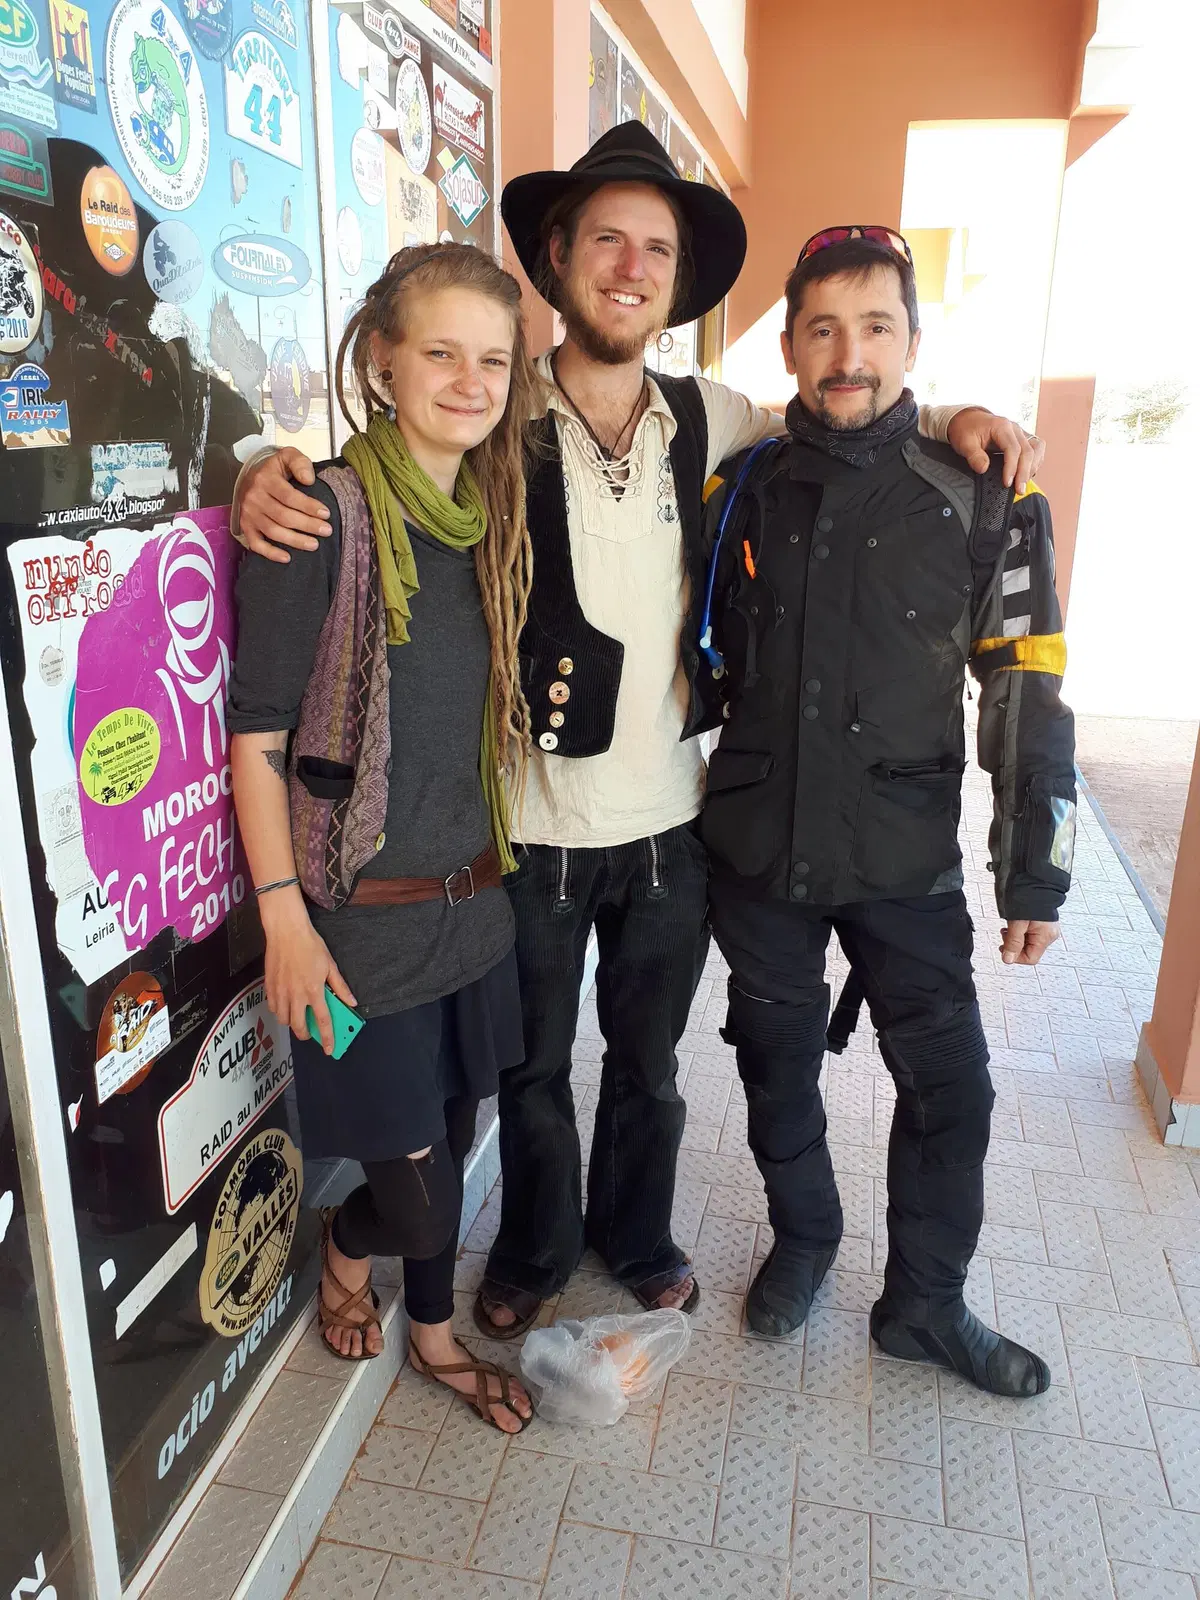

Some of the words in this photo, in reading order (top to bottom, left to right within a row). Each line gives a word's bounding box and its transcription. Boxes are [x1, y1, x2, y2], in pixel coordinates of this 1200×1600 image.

[367, 12, 383, 30] CLUB
[403, 37, 420, 57] RANGE
[84, 210, 136, 231] Baroudeurs
[87, 198, 98, 210] Le
[100, 200, 118, 214] Raid
[119, 206, 131, 216] des
[7, 318, 29, 338] 2018
[7, 410, 61, 420] RALLY
[23, 540, 111, 590] mundo
[85, 741, 97, 757] Le
[96, 718, 121, 742] Temps
[124, 713, 134, 727] De
[137, 713, 155, 735] Vivre
[191, 874, 245, 938] 2010
[85, 922, 115, 949] Leiria
[199, 1050, 211, 1077] 27
[246, 987, 264, 1011] Mai
[218, 1027, 256, 1079] CLUB
[200, 1119, 232, 1166] RAID
[237, 1104, 251, 1127] au
[264, 1134, 286, 1152] CLUB
[242, 1178, 293, 1256] VALLÈS
[157, 1379, 216, 1480] ocio
